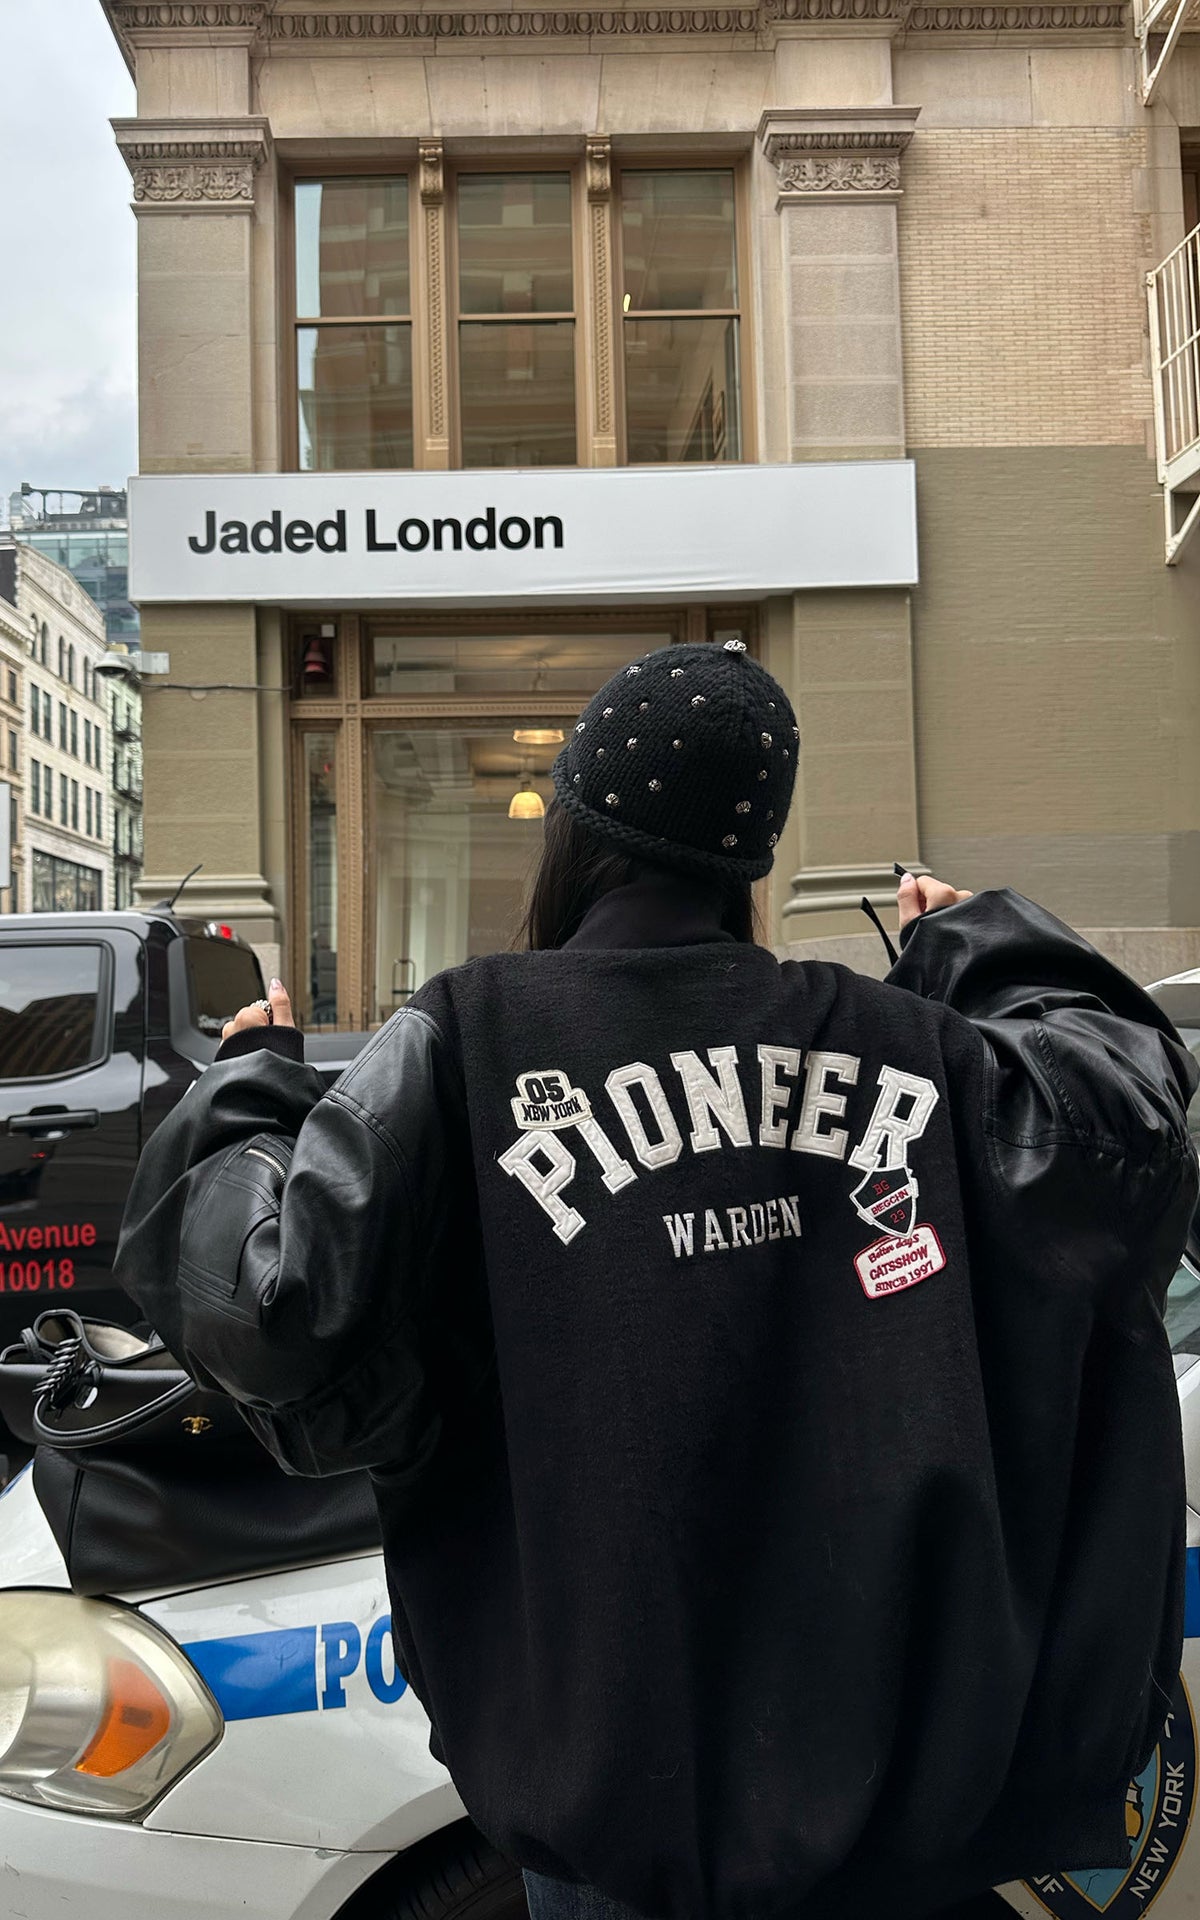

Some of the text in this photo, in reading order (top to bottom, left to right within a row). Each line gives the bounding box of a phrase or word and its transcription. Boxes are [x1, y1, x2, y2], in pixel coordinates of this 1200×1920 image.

[188, 506, 564, 554] Jaded London
[525, 1076, 565, 1105] 05
[521, 1096, 584, 1122] NEW YORK
[497, 1043, 940, 1247] PIONEER
[872, 1179, 891, 1196] BG
[662, 1195, 802, 1258] WARDEN
[889, 1208, 906, 1224] 23
[0, 1221, 97, 1252] Avenue
[0, 1257, 76, 1293] 10018
[869, 1244, 928, 1281] CATSSHOW
[875, 1259, 935, 1292] SINCE 1997
[1129, 1837, 1170, 1900] NEW
[1158, 1760, 1186, 1829] YORK
